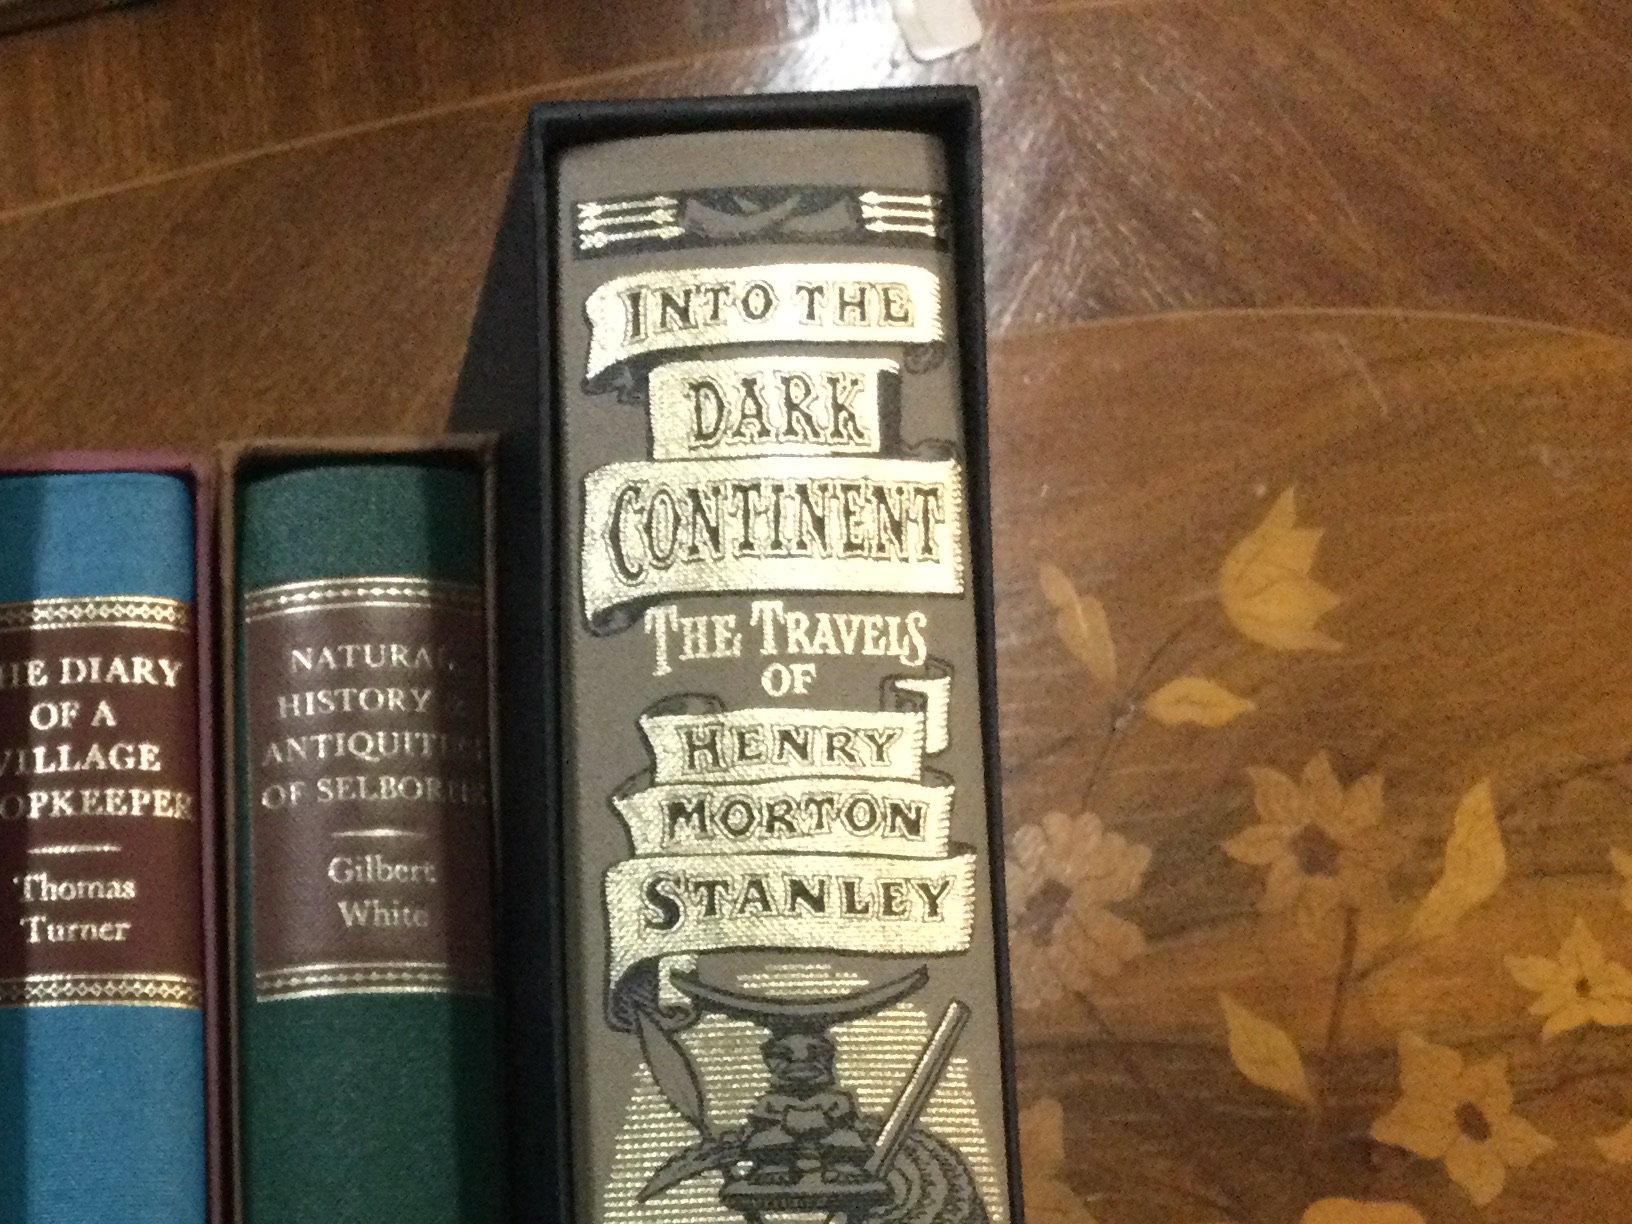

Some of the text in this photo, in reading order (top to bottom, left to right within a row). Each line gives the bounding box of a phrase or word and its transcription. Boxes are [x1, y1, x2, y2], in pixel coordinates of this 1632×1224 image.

[621, 278, 916, 344] INTO THE
[688, 371, 874, 448] DARK
[605, 477, 947, 584] CONTINENT
[644, 601, 927, 677] THE TRAVELS
[59, 656, 184, 690] DIARY
[760, 663, 818, 696] OF
[29, 697, 119, 730] OF A
[277, 687, 435, 719] HISTORY
[679, 719, 904, 774] HENRY
[260, 780, 307, 810] OF
[661, 793, 929, 848] MORTON
[327, 855, 438, 885] Gilbert
[13, 873, 137, 902] Thomas
[639, 871, 953, 933] STANLEY
[20, 917, 132, 943] Turner
[338, 900, 430, 928] White
